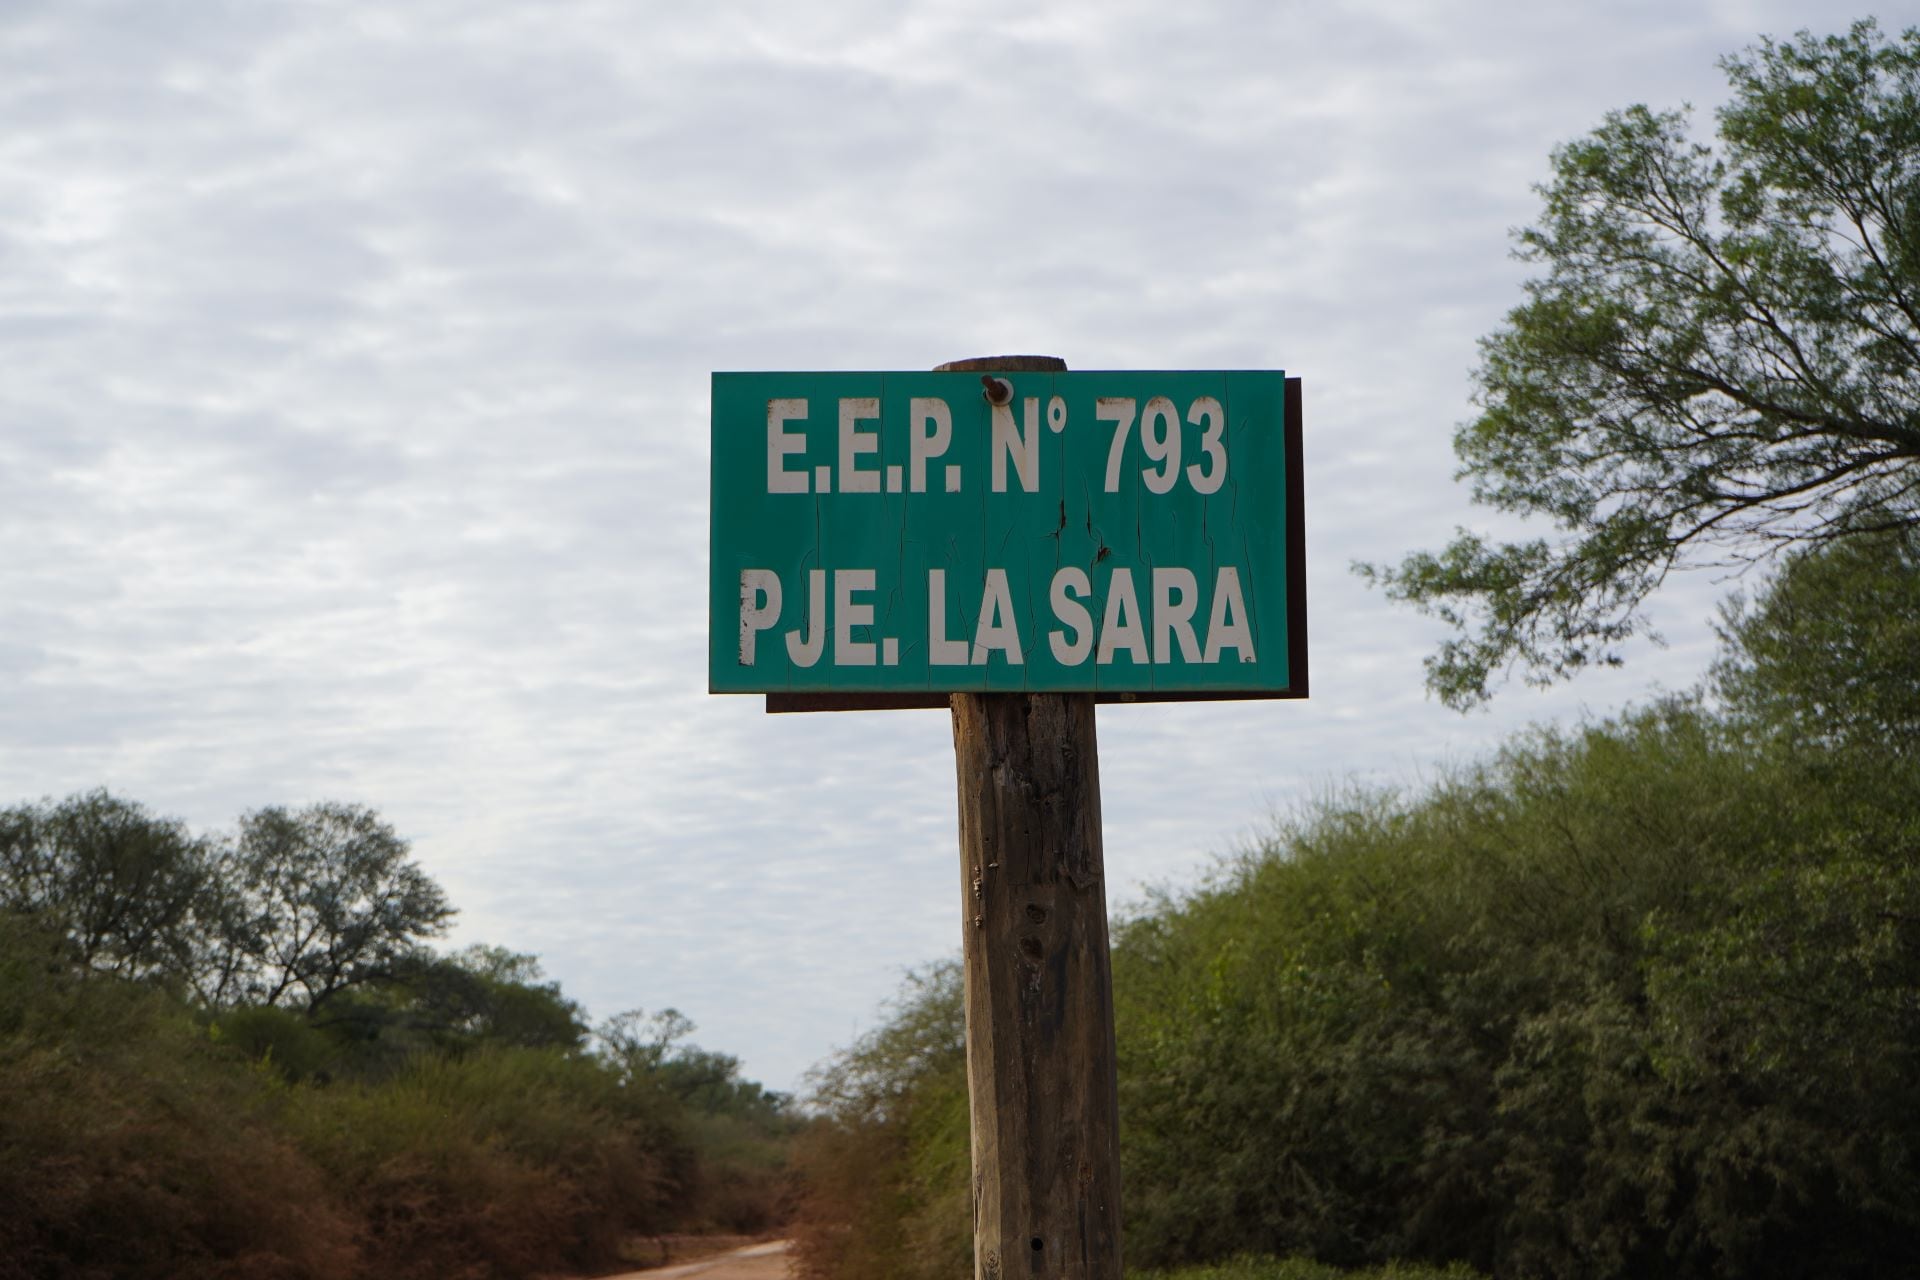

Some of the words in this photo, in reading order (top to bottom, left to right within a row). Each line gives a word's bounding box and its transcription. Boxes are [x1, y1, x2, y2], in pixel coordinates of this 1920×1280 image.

[767, 398, 961, 494] E.E.P.
[1095, 397, 1227, 494] 793
[738, 569, 899, 668] PJE.
[928, 568, 1024, 666] LA
[1048, 566, 1257, 666] SARA
